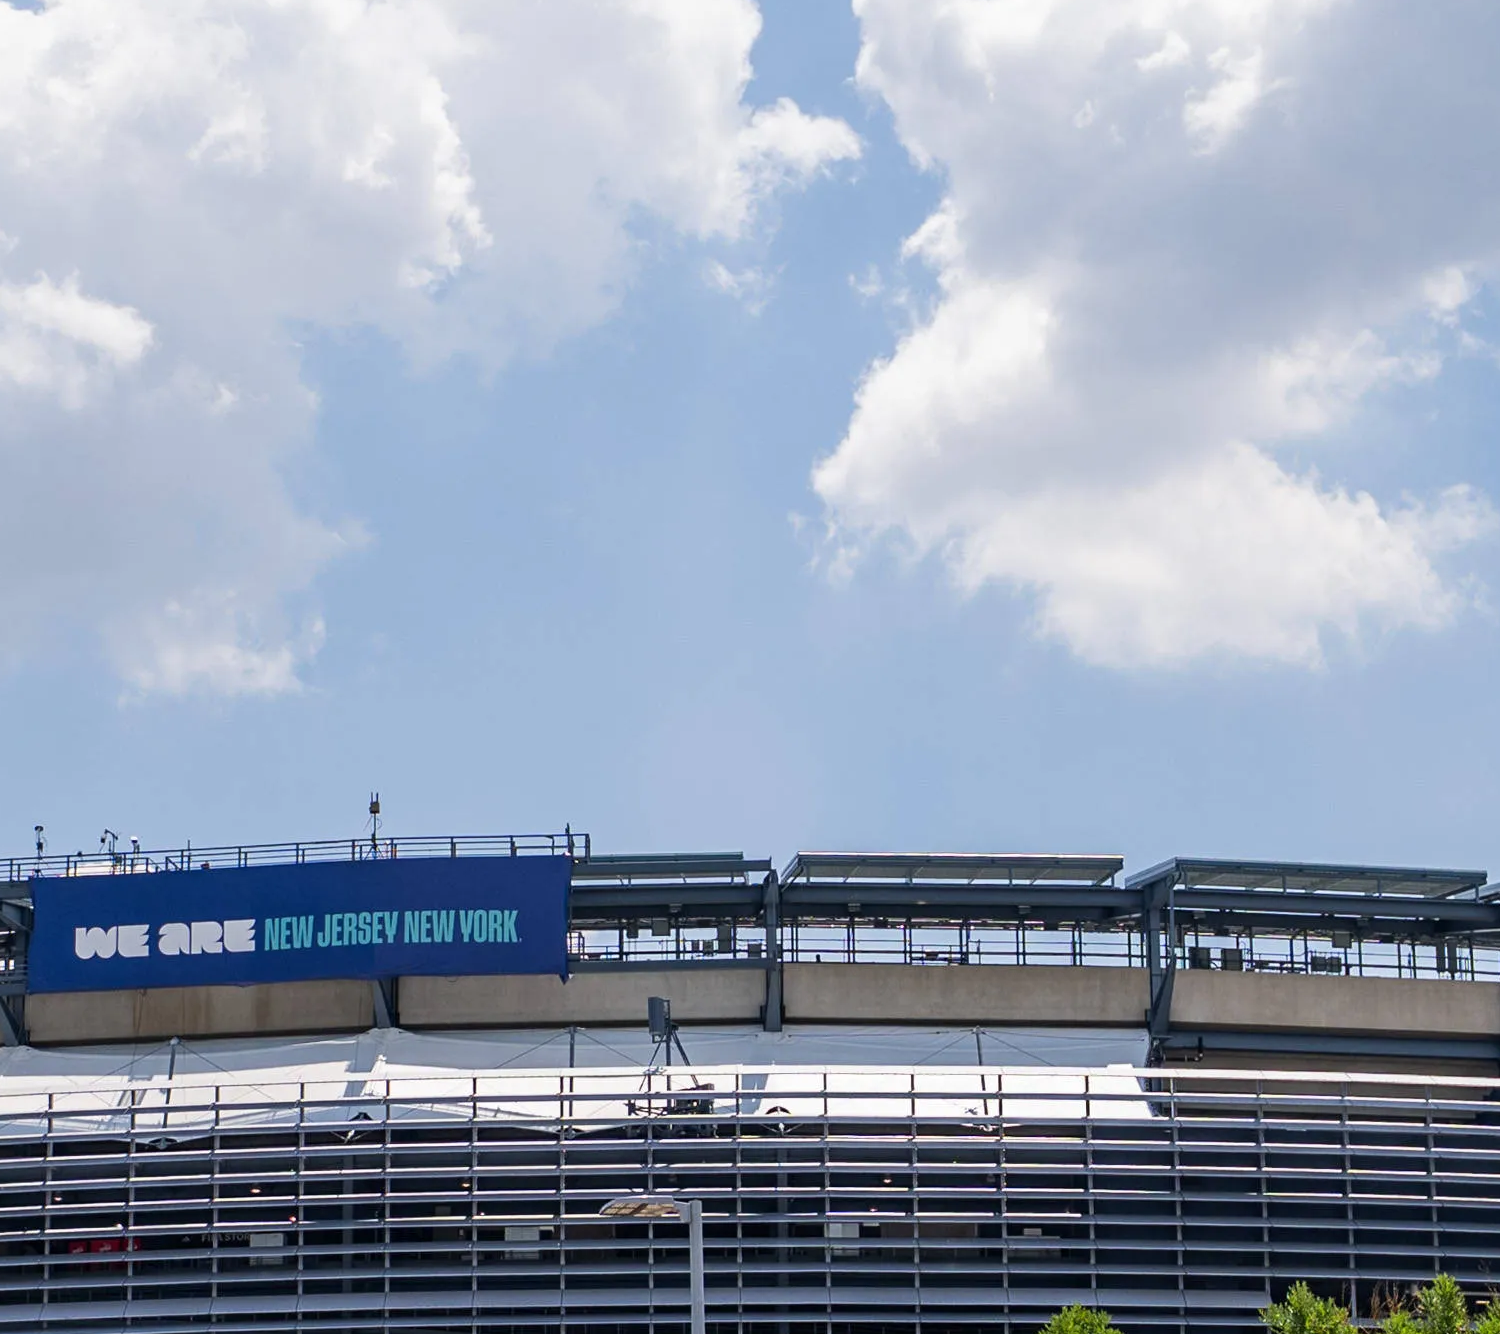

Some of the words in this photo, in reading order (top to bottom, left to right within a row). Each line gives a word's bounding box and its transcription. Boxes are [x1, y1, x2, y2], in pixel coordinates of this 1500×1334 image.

[75, 923, 150, 959] WE
[158, 919, 256, 955] ARE
[264, 916, 315, 951] NEW
[317, 911, 399, 948] JERSEY
[404, 909, 456, 944] NEW
